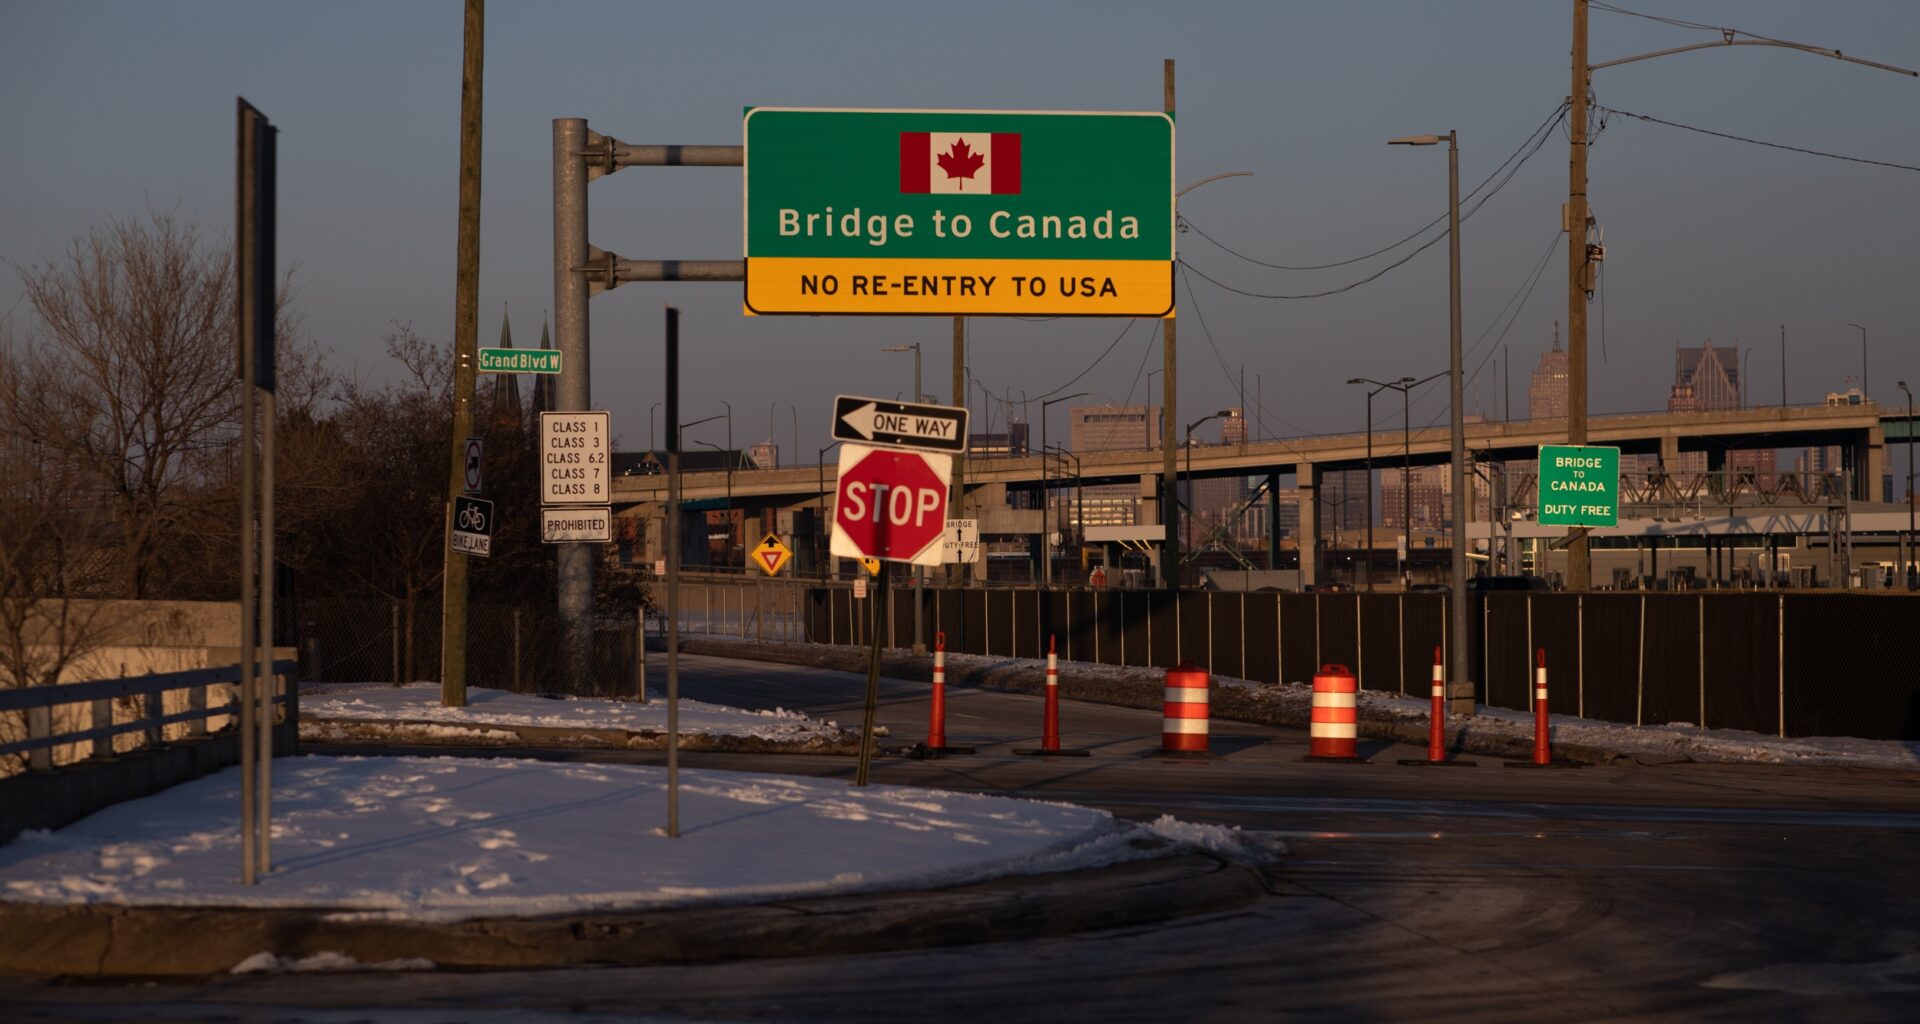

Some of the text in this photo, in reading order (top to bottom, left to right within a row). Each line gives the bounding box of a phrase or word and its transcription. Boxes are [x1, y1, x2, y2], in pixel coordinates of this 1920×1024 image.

[779, 207, 1140, 246] Bridge to Canada
[801, 275, 1118, 298] NO RE-ENTRY TO USA
[482, 352, 559, 369] Grand Blvd W
[553, 422, 598, 432] CLASS 1
[873, 414, 952, 437] ONE WAY
[552, 437, 600, 448] CLASS 3
[547, 453, 605, 464] CLASS 6.2
[1555, 457, 1602, 468] BRIDGE
[552, 468, 600, 479] CLASS 7
[1573, 470, 1585, 479] TO
[552, 484, 600, 494] CLASS 8
[1551, 481, 1606, 492] CANADA
[843, 480, 940, 528] STOP
[1545, 504, 1611, 516] DUTY FREE
[547, 519, 605, 531] PROHIBITED
[453, 533, 489, 552] BIKE LANE
